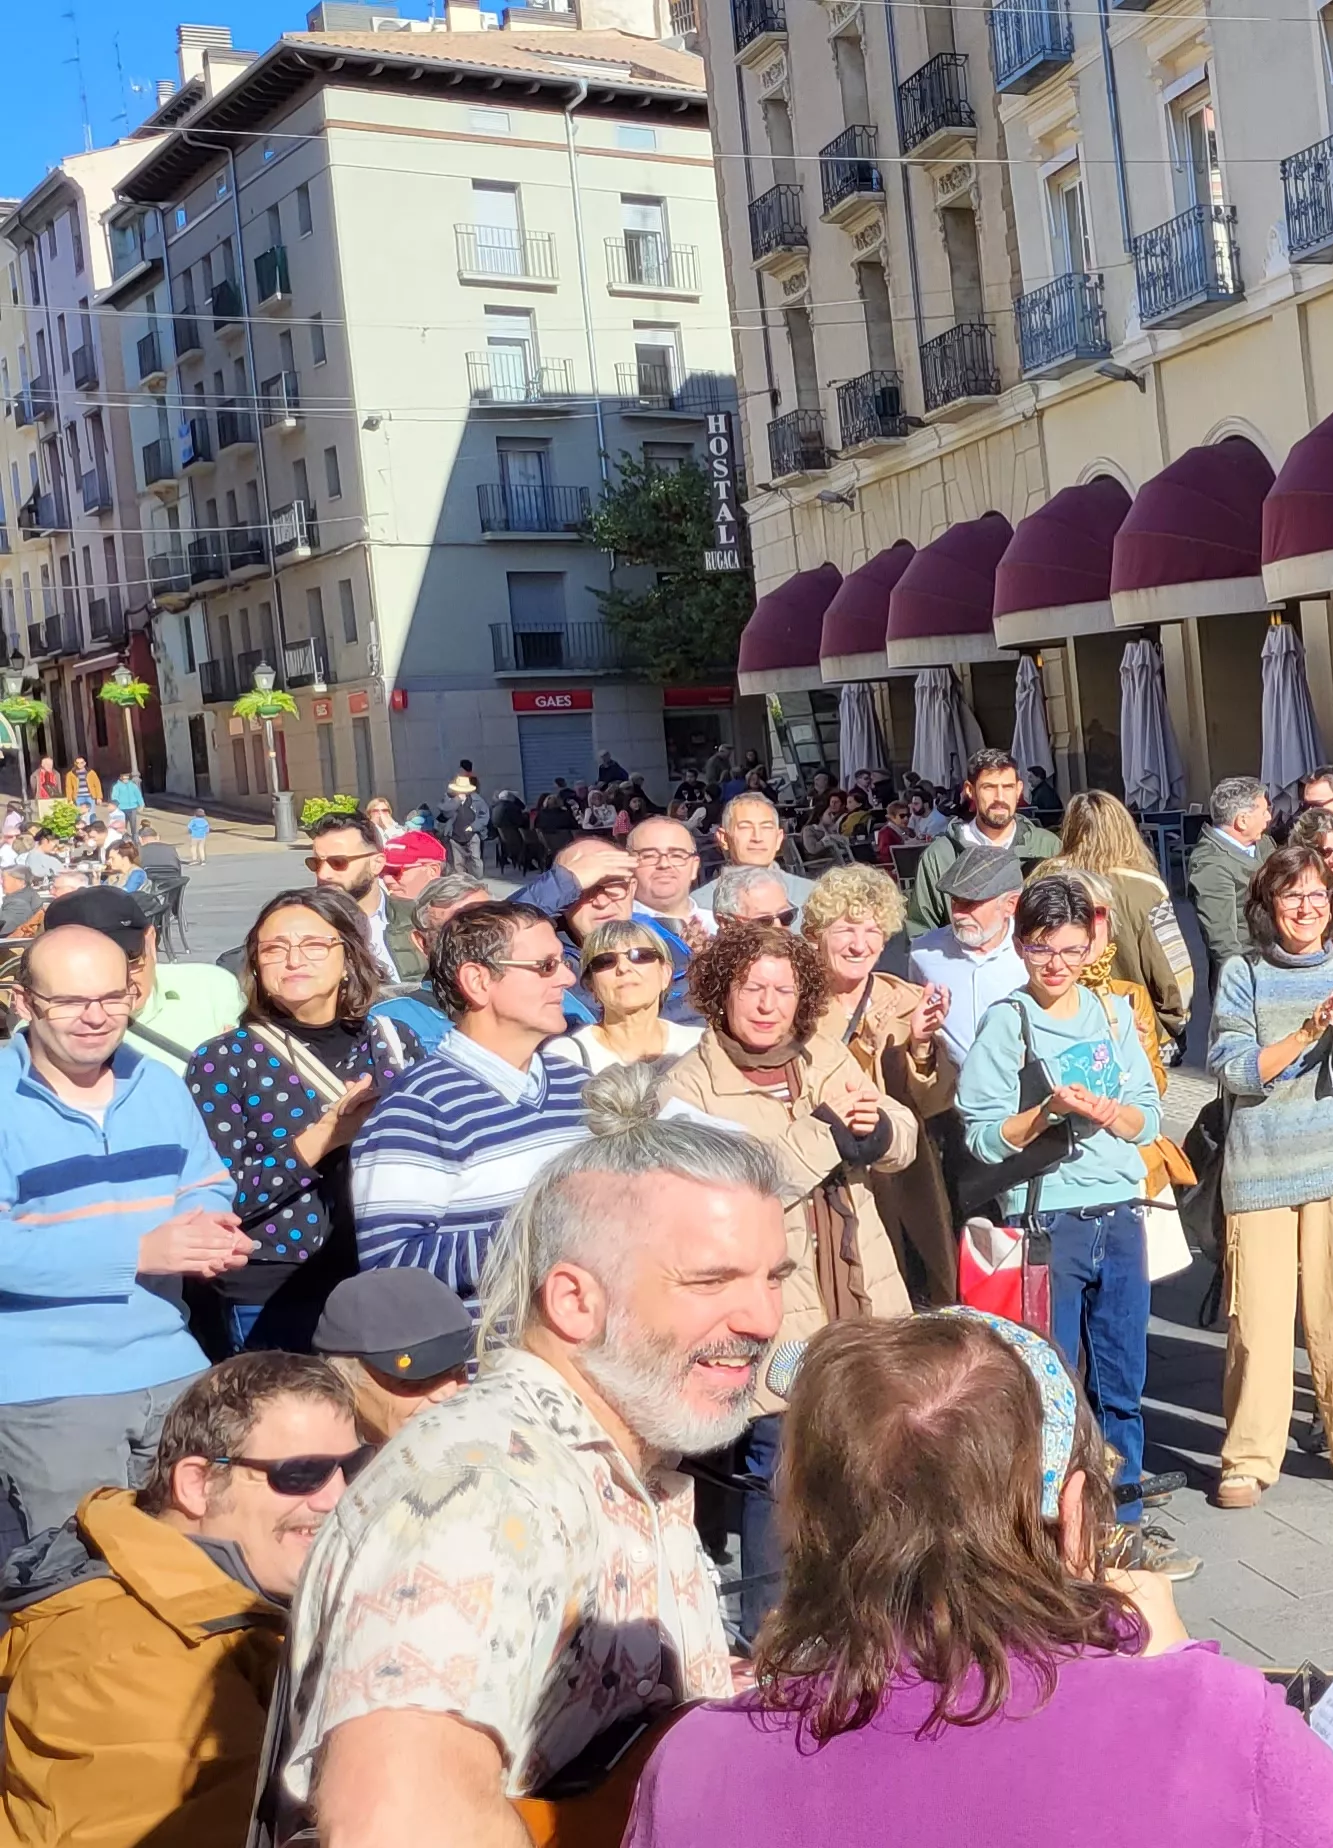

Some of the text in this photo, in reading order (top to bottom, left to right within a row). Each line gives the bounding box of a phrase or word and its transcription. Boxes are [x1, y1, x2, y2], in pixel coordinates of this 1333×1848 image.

[706, 414, 735, 544] HOSTAL
[705, 550, 740, 571] RUGACA
[535, 695, 572, 708] GAES
